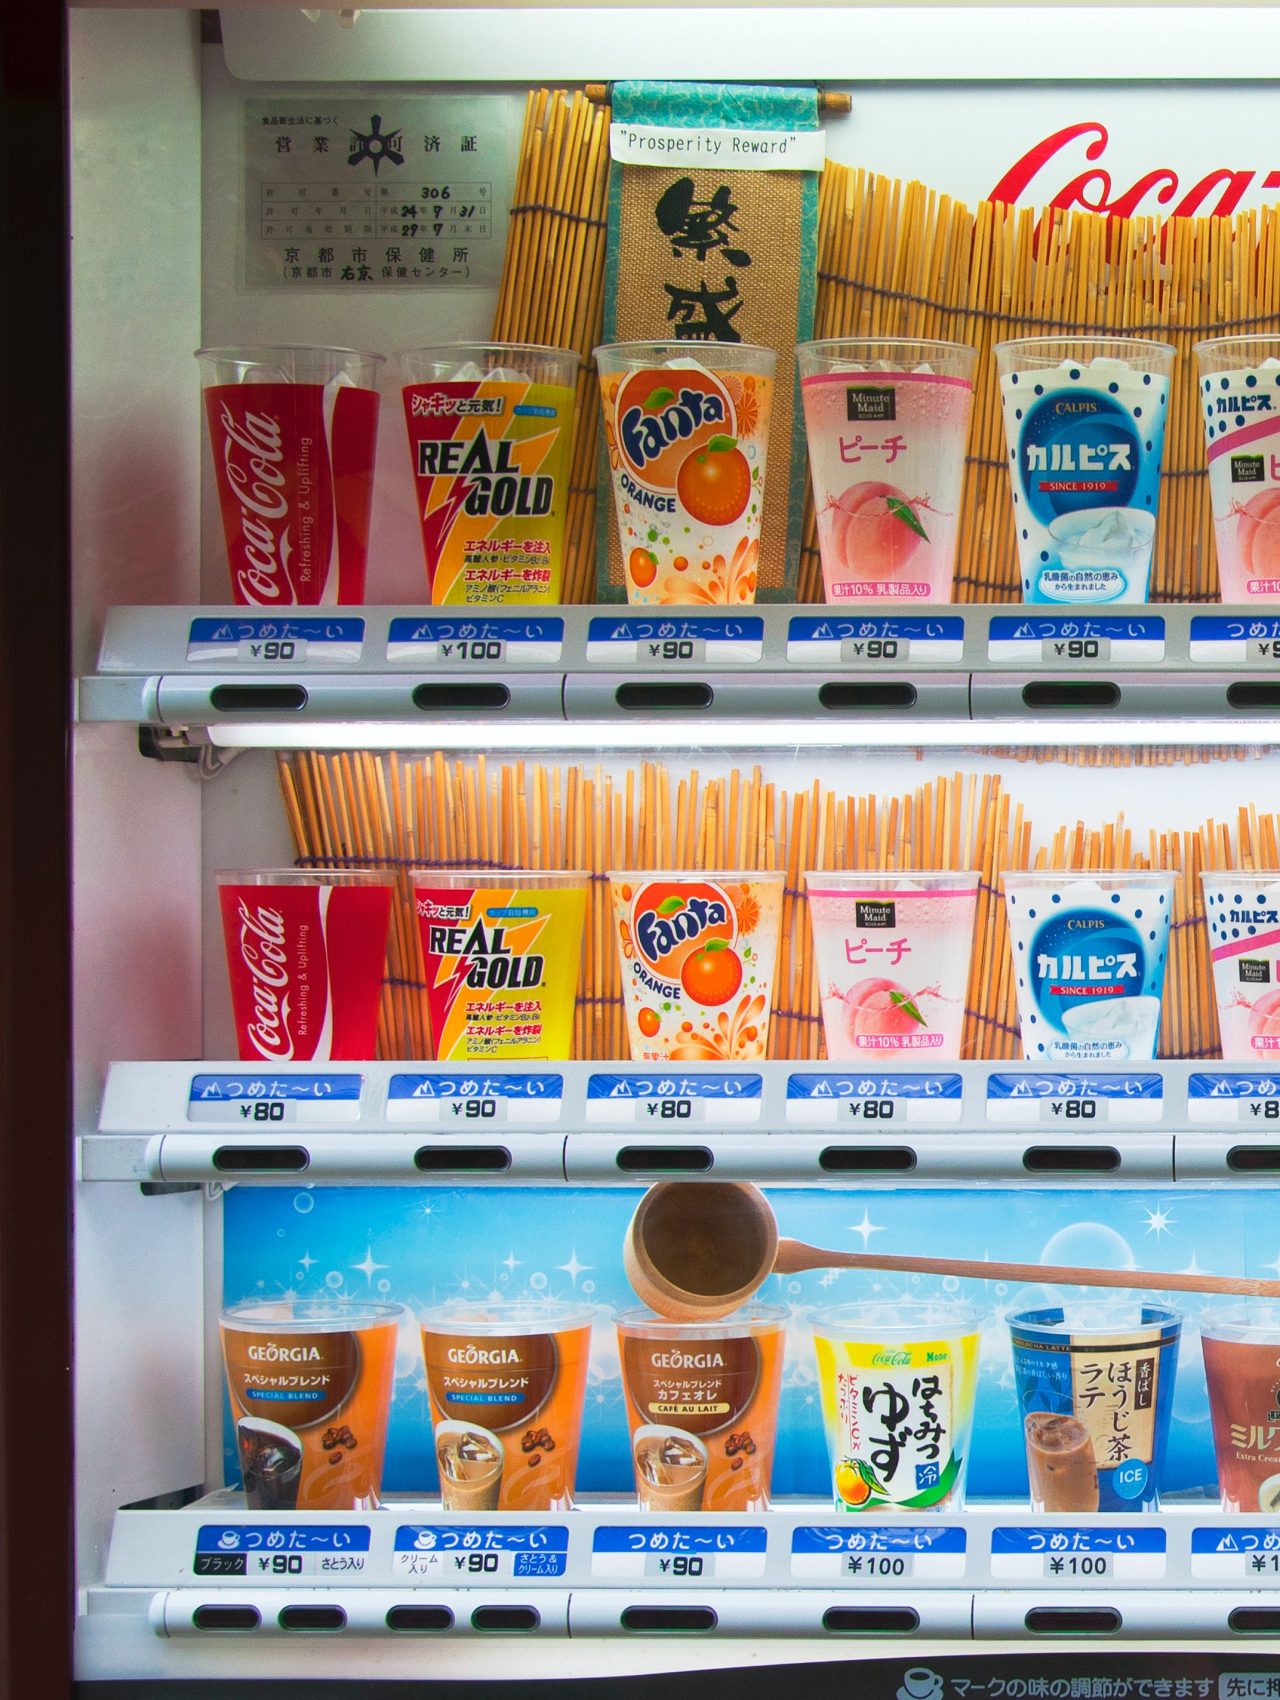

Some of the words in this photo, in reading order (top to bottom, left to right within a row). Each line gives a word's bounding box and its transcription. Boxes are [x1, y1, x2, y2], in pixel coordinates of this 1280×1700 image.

[285, 248, 468, 263] 京都市保健所
[852, 392, 890, 403] Minute
[857, 403, 884, 412] Maid
[1056, 403, 1097, 415] CALPIS
[622, 389, 724, 468] Fanta
[419, 425, 519, 474] REAL
[839, 435, 907, 463] ピーチ
[1027, 444, 1131, 471] カルピス
[300, 437, 312, 495] Uplifting
[219, 399, 288, 605] Coca-Cola
[465, 477, 553, 516] GOLD
[621, 474, 676, 512] ORANGE
[300, 501, 310, 510] &
[300, 516, 312, 582] Refreshing
[250, 642, 294, 660] ¥90
[441, 642, 501, 660] ¥100
[649, 642, 693, 659] ¥90
[853, 641, 897, 658] ¥90
[1054, 641, 1098, 658] ¥90
[430, 918, 510, 954] REAL
[638, 899, 725, 961] Fanta
[845, 938, 911, 965] ピーチ
[238, 896, 294, 1061] Coca-Cola
[468, 956, 543, 989] GOLD
[633, 962, 681, 1000] ORANGE
[240, 1102, 284, 1121] ¥80
[452, 1100, 495, 1117] ¥90
[647, 1100, 691, 1118] ¥80
[849, 1100, 894, 1118] ¥80
[1051, 1100, 1095, 1118] ¥80
[872, 1352, 912, 1366] Coca-Cola
[244, 1374, 330, 1386] スペシャルブレンド
[1079, 1363, 1105, 1408] ラテ
[1138, 1362, 1152, 1406] 香ばし
[912, 1376, 946, 1460] はちみつ
[1107, 1362, 1132, 1461] ほうじ茶
[863, 1383, 911, 1481] ゆず
[919, 1466, 937, 1484] 冷
[1120, 1469, 1142, 1483] ICE
[200, 1558, 245, 1570] ブラック
[258, 1555, 302, 1574] ¥90
[454, 1554, 498, 1572] ¥90
[659, 1557, 703, 1576] ¥90
[848, 1556, 904, 1575] ¥100
[1050, 1557, 1106, 1574] ¥100
[950, 1677, 1213, 1699] マークの味の調節ができます
